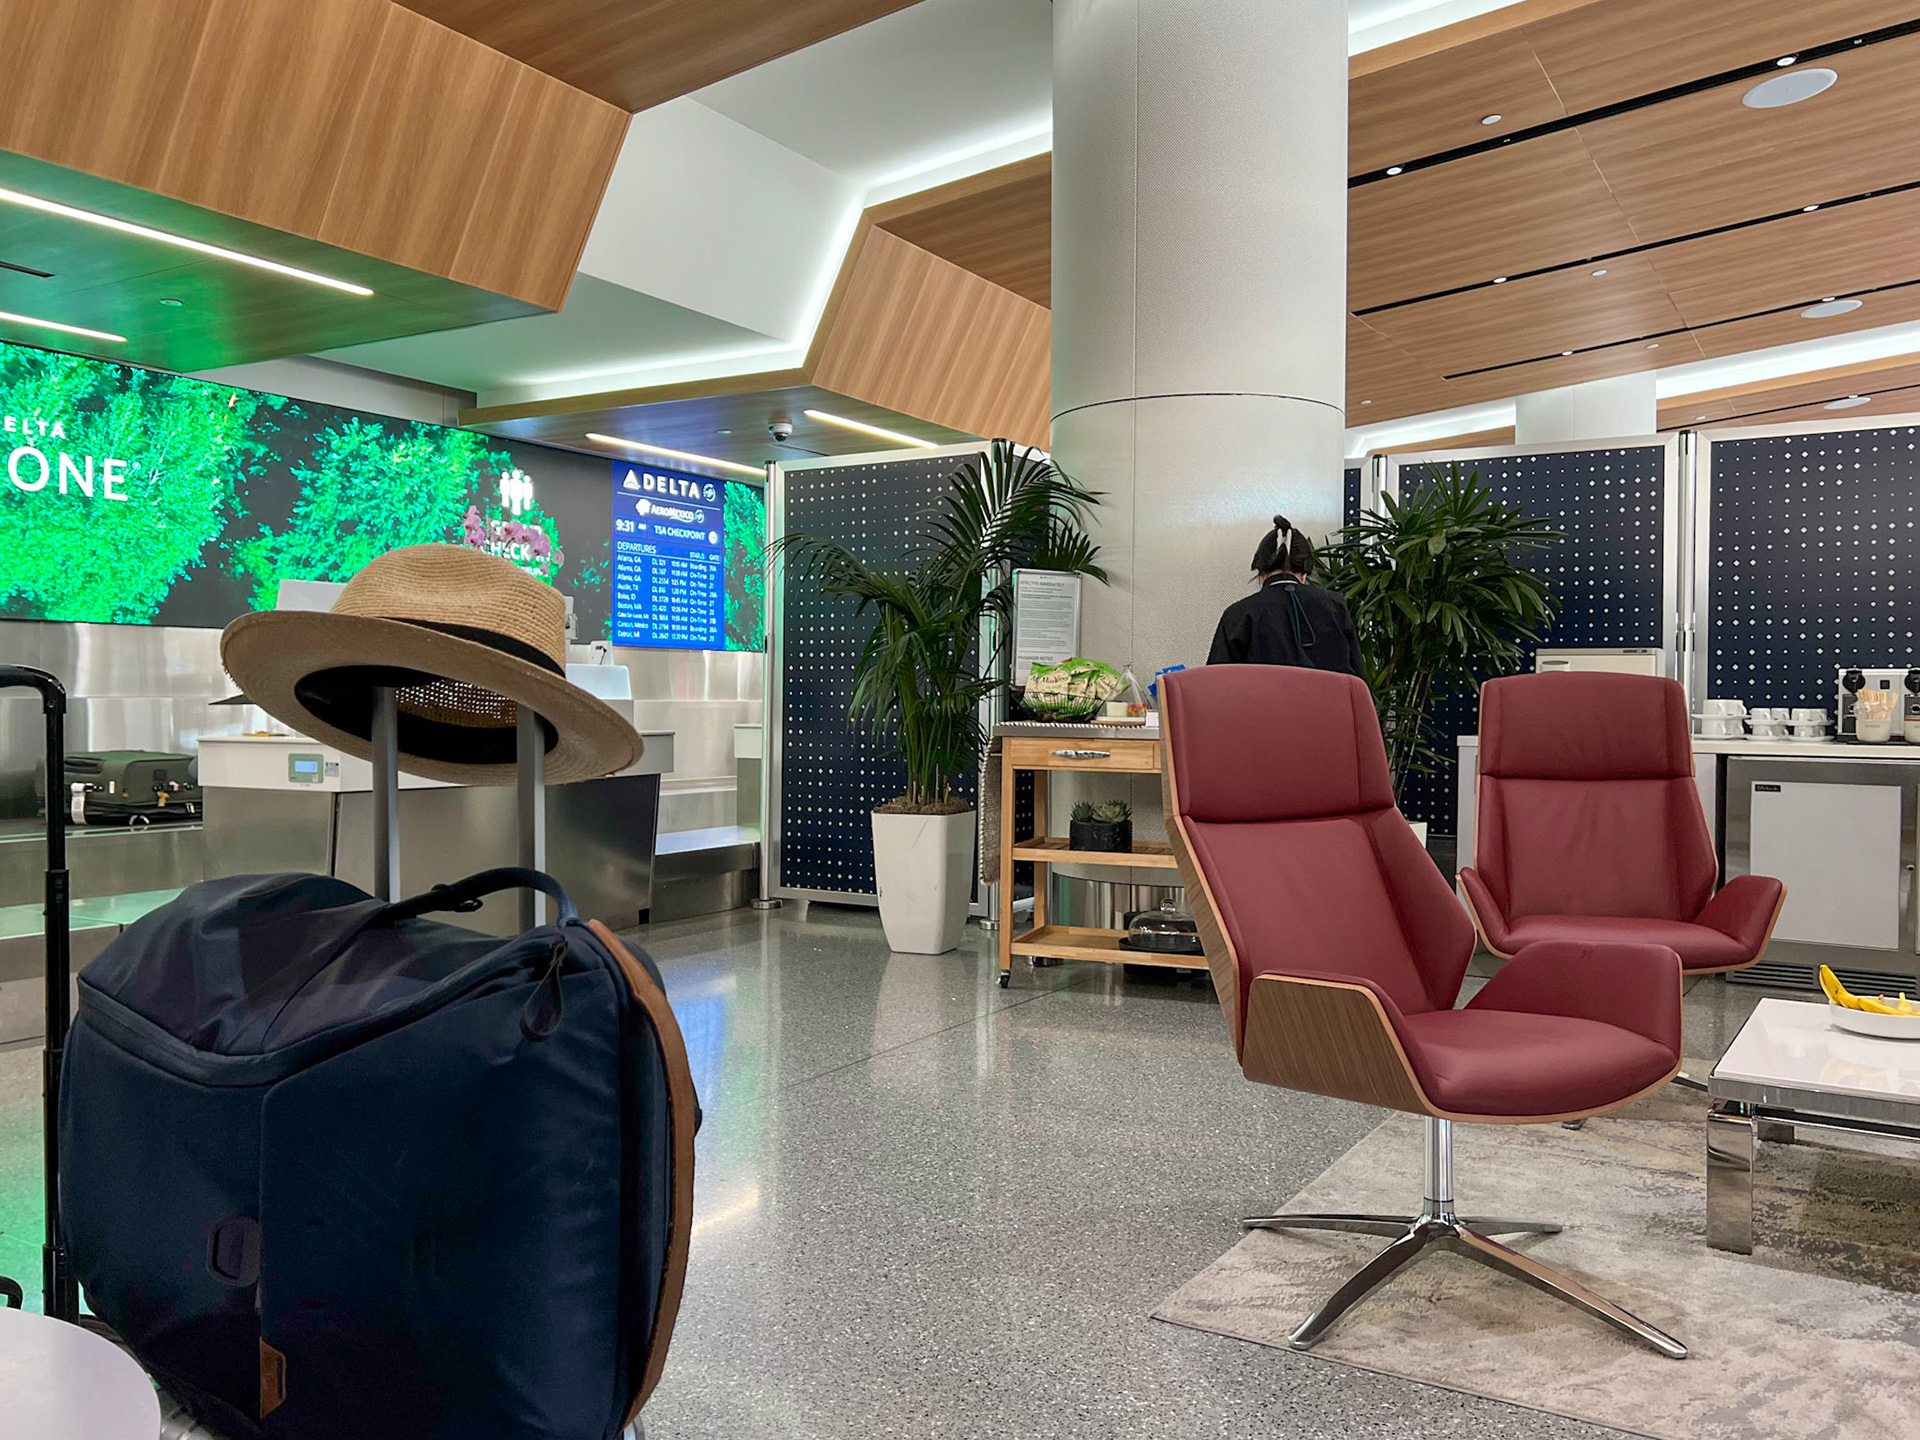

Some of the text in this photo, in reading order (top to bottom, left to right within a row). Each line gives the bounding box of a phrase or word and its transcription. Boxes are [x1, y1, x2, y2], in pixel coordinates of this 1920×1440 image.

[8, 446, 128, 501] ONE
[642, 472, 700, 500] DELTA
[616, 519, 634, 532] 9:31
[654, 525, 666, 535] TSA
[667, 526, 706, 540] CHECKPOINT
[617, 541, 656, 554] DEPARTURES
